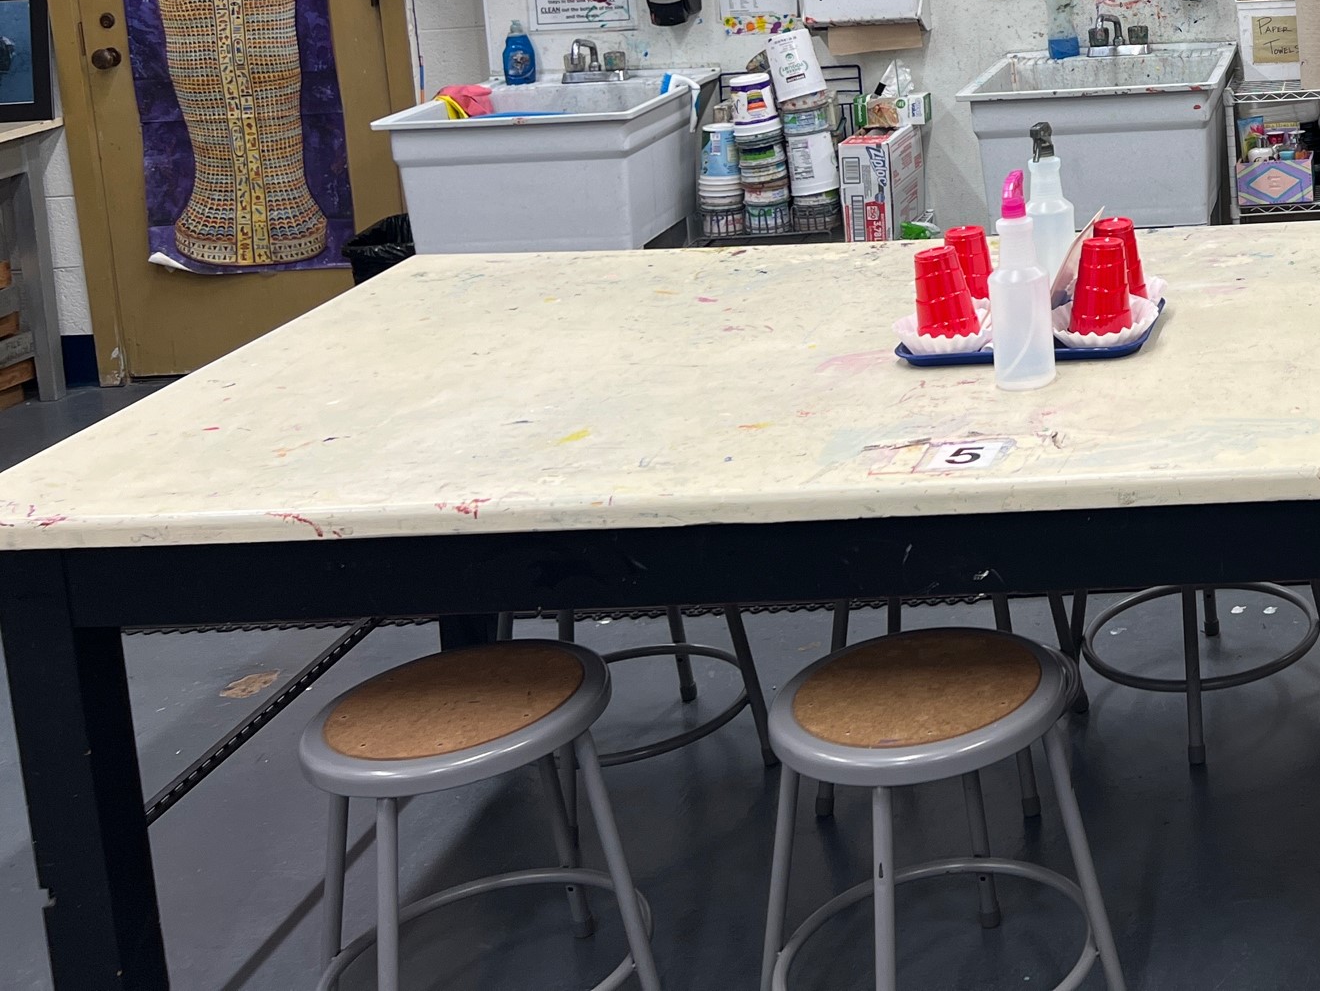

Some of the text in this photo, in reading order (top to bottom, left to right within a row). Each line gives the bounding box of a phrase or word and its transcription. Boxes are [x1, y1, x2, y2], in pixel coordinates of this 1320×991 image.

[540, 6, 560, 14] CLEAN
[1256, 17, 1293, 36] PAPER
[866, 146, 887, 187] Ziploc
[944, 446, 985, 464] 5
